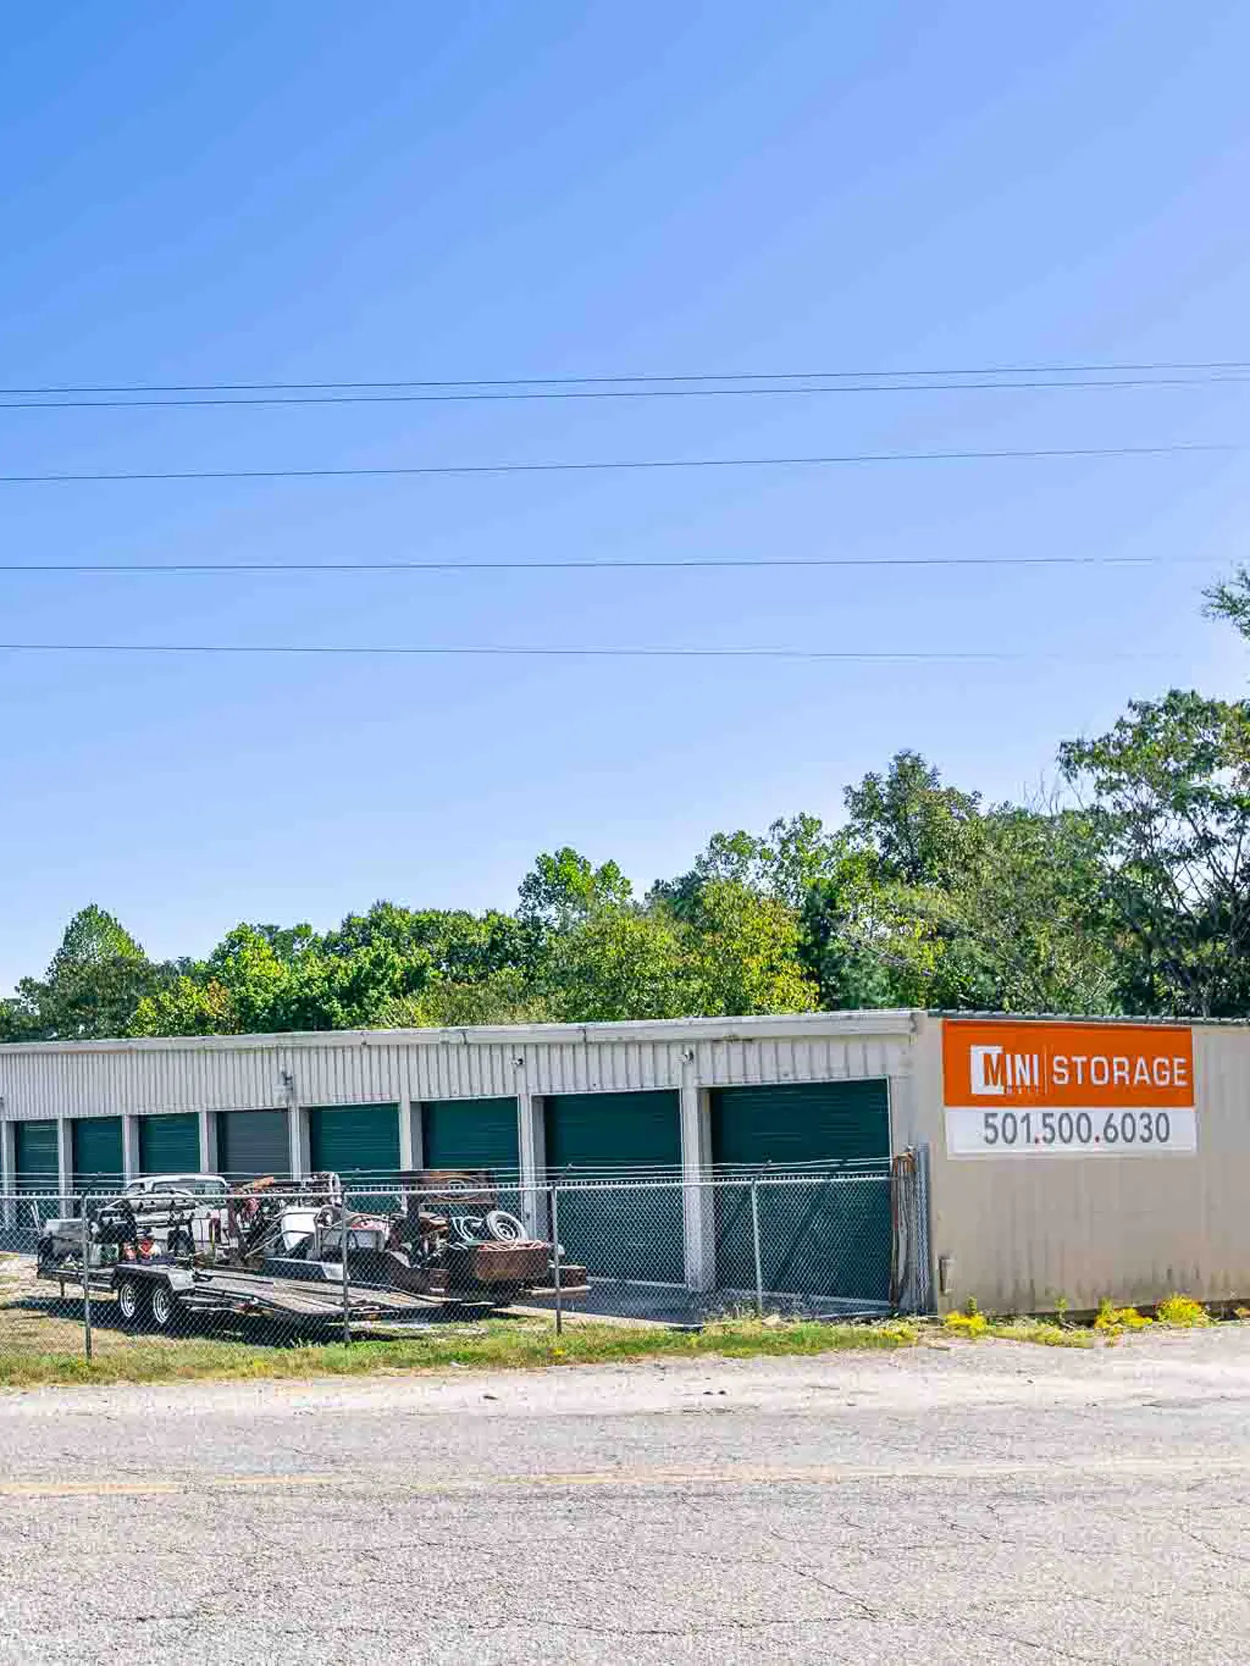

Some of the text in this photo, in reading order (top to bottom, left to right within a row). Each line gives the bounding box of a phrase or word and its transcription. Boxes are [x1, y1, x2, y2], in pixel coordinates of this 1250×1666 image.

[980, 1051, 1188, 1088] MINI STORAGE
[983, 1112, 1170, 1144] 501.500.6030
